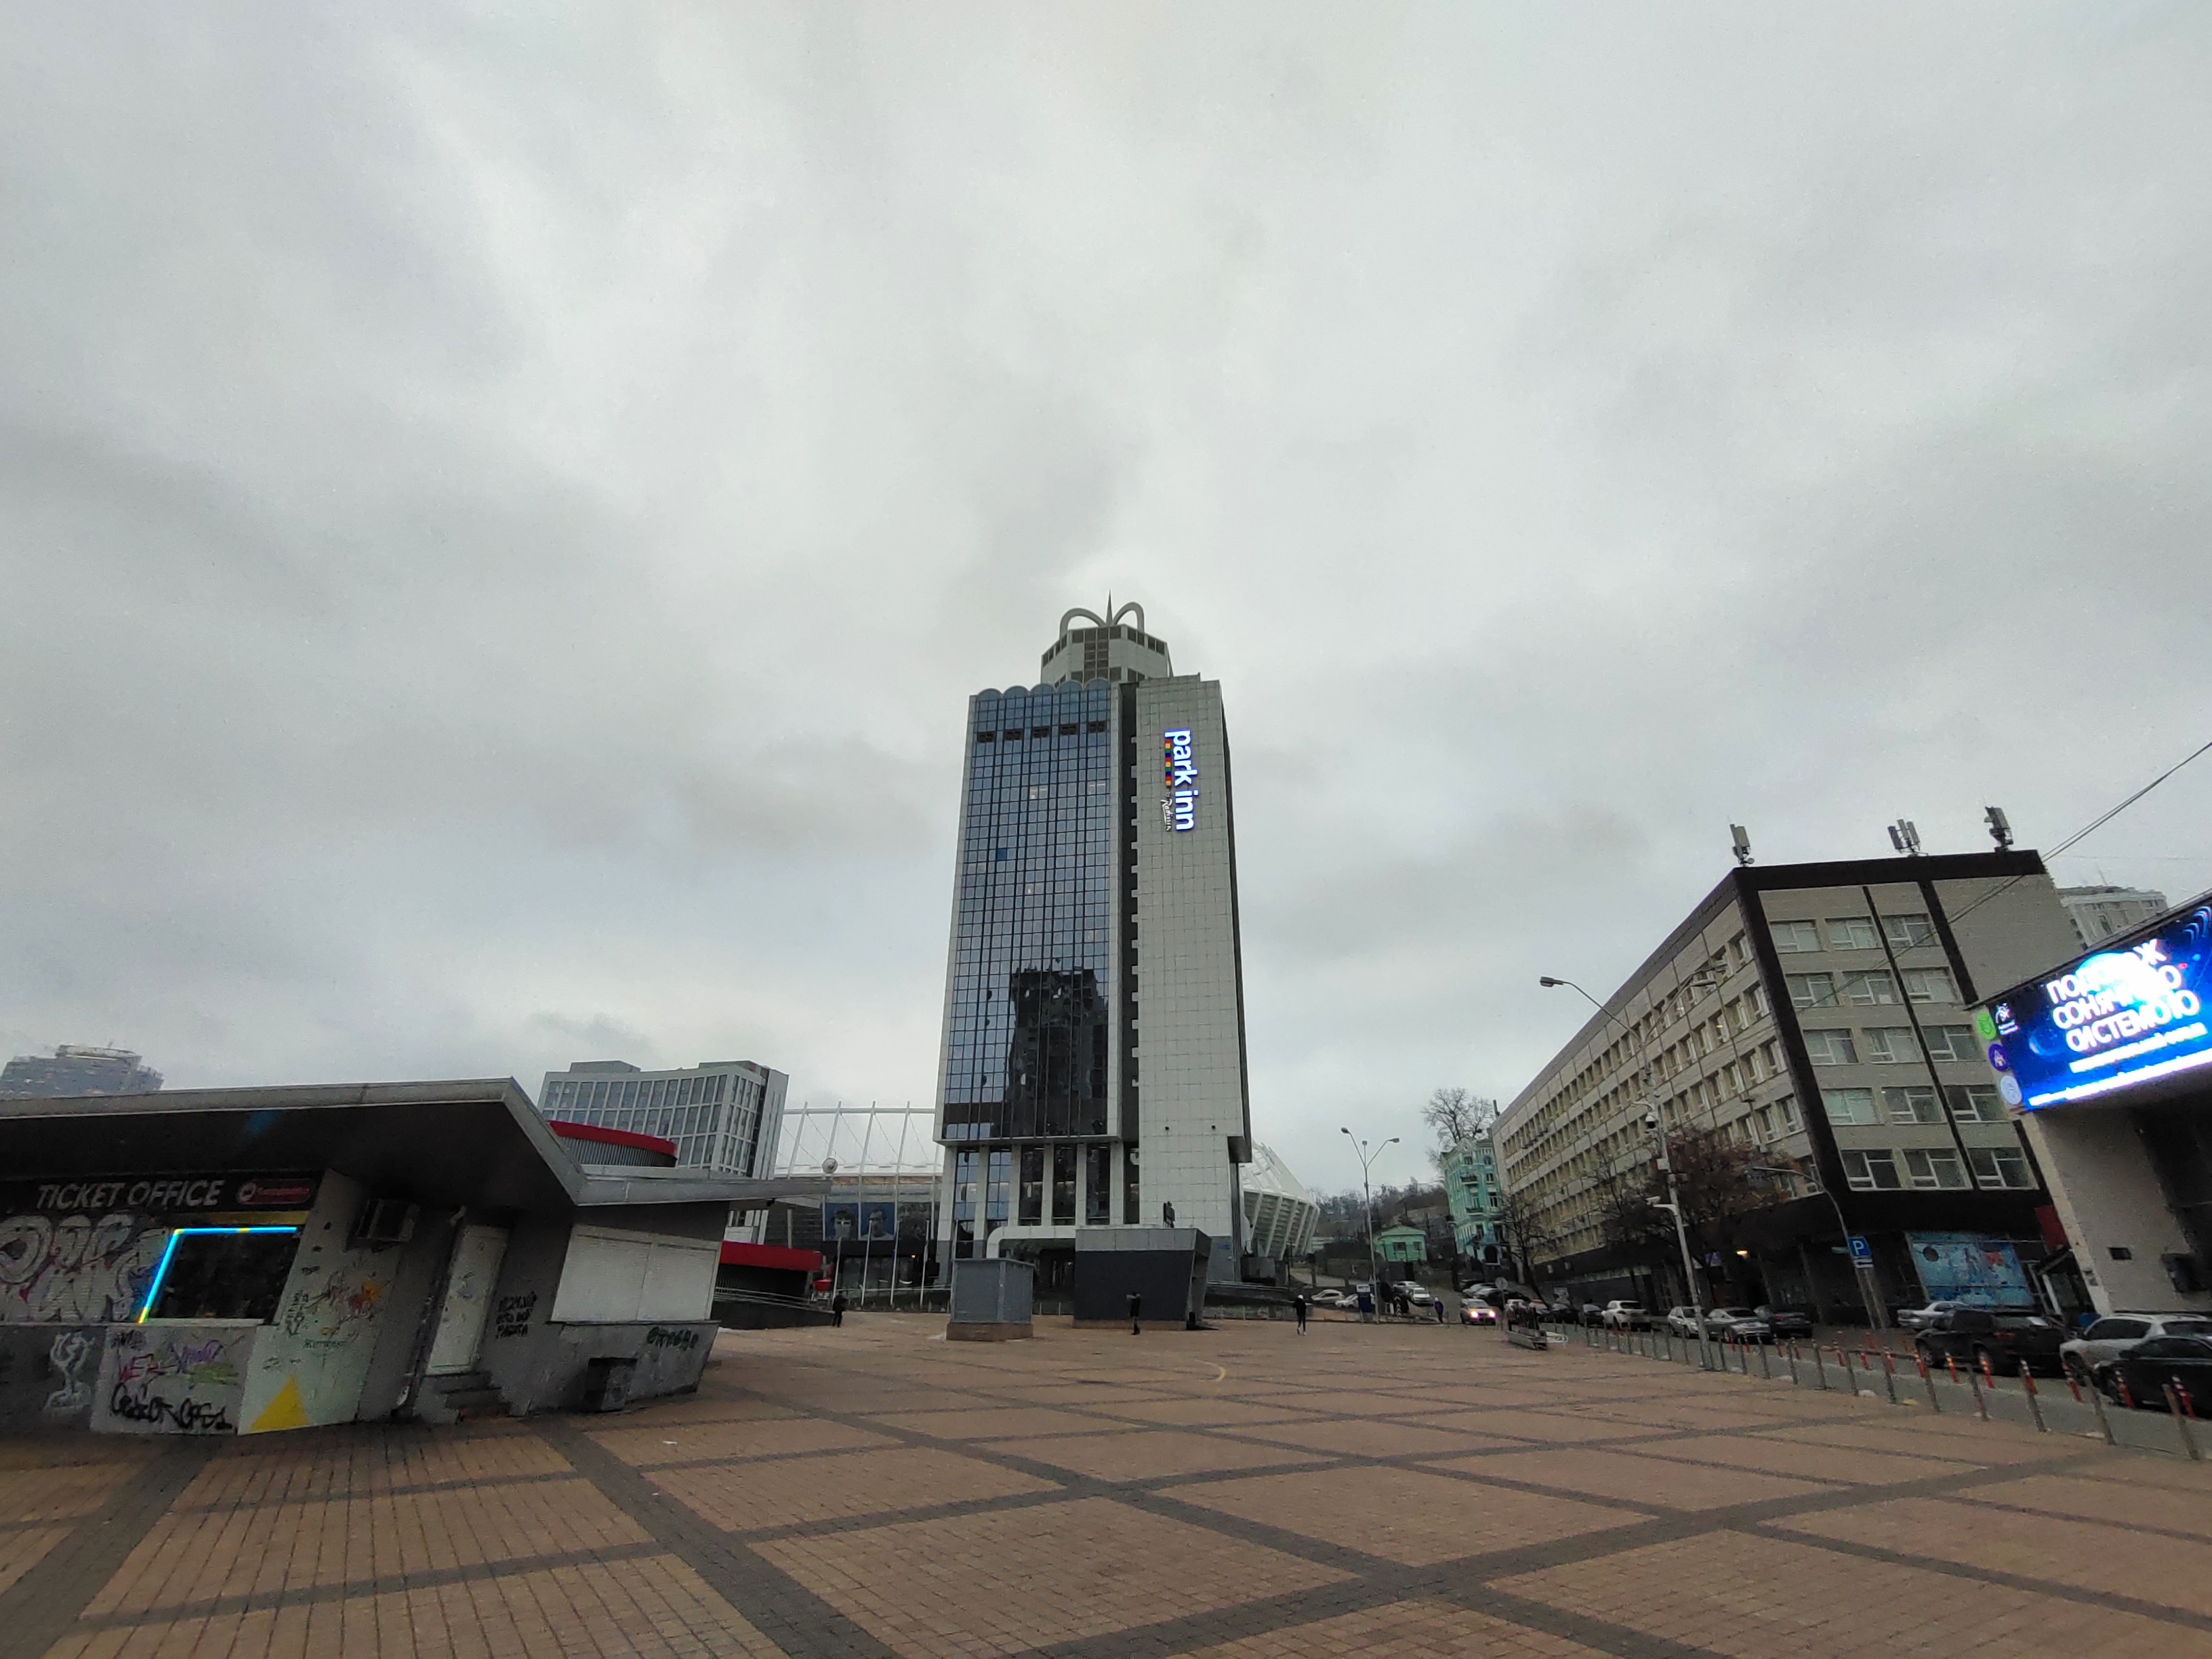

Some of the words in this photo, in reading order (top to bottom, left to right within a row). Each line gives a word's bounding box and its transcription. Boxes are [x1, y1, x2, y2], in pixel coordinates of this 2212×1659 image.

[1164, 729, 1197, 786] park
[1174, 790, 1199, 830] inn
[2067, 991, 2199, 1050] СИСТЕМОЮ
[36, 1182, 126, 1210] TICKET
[127, 1180, 226, 1207] OFFICE
[1852, 1240, 1865, 1255] P
